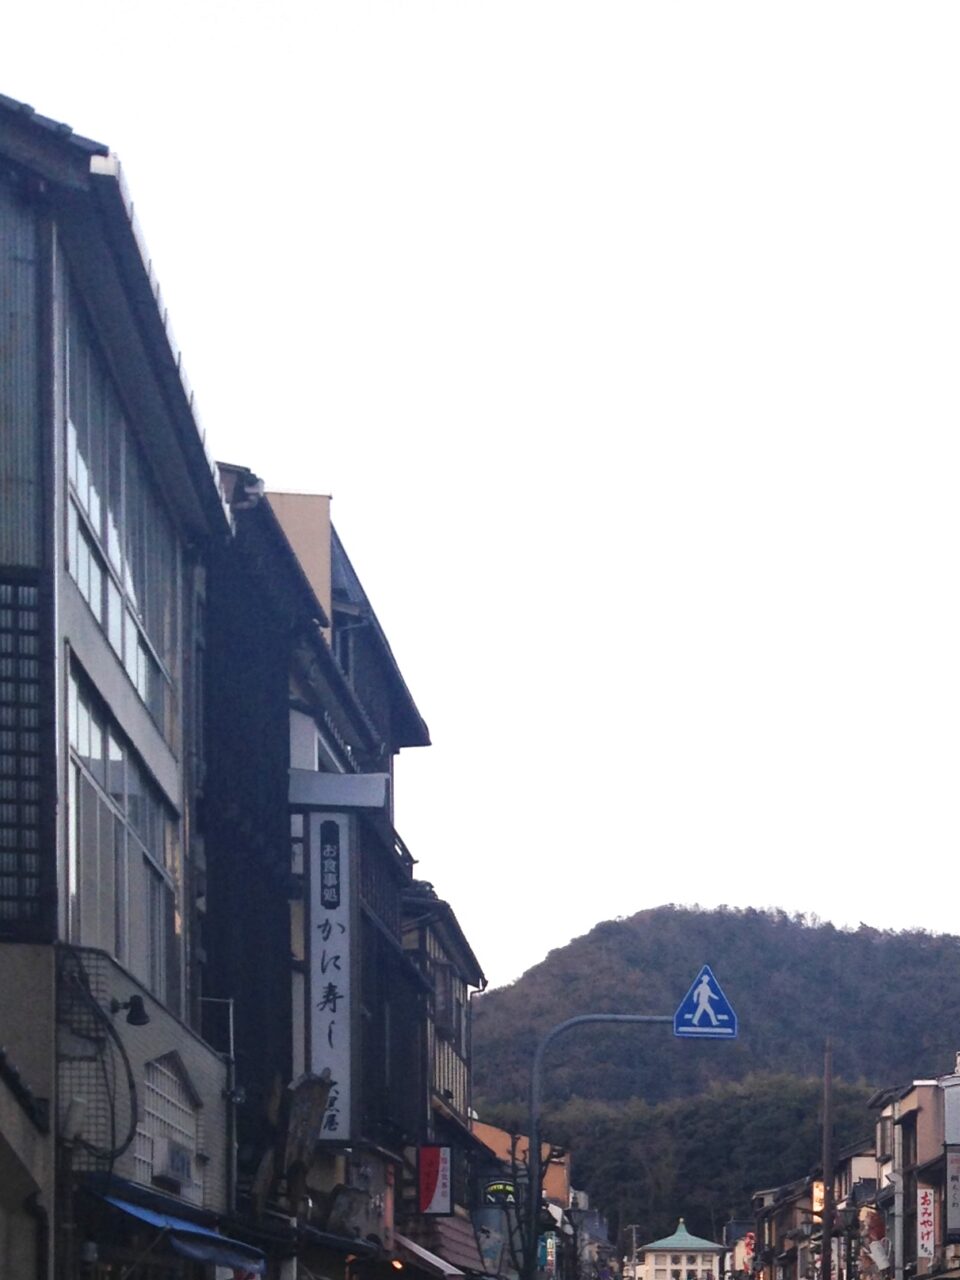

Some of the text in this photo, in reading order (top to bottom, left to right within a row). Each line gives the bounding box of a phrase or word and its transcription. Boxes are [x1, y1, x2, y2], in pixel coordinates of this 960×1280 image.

[322, 843, 338, 902] お食事処
[316, 918, 346, 1050] かに寿し
[919, 1190, 933, 1241] おみやげ
